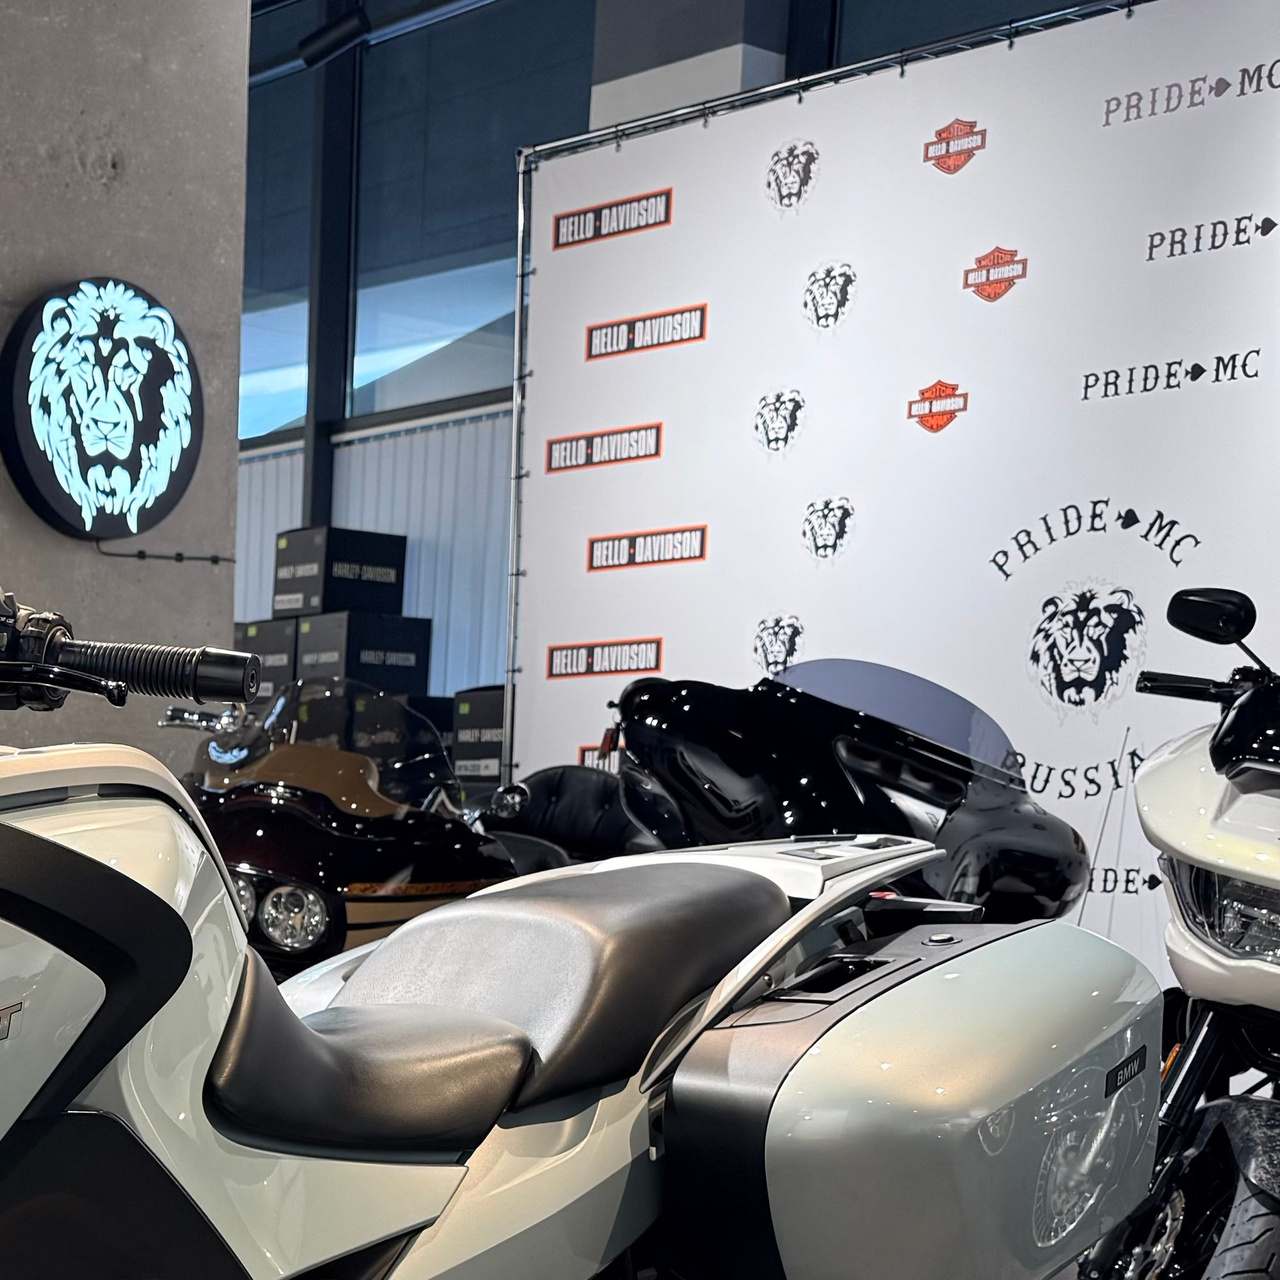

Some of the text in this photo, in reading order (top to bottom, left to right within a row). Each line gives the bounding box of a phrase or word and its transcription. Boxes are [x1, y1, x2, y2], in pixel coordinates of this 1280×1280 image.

[1102, 75, 1208, 127] PRIDE
[1145, 213, 1254, 262] PRIDE
[1081, 347, 1261, 402] PRIDE MC
[988, 497, 1202, 582] PRIDE MC
[1087, 866, 1141, 895] IDE
[1117, 1056, 1140, 1087] BMW
